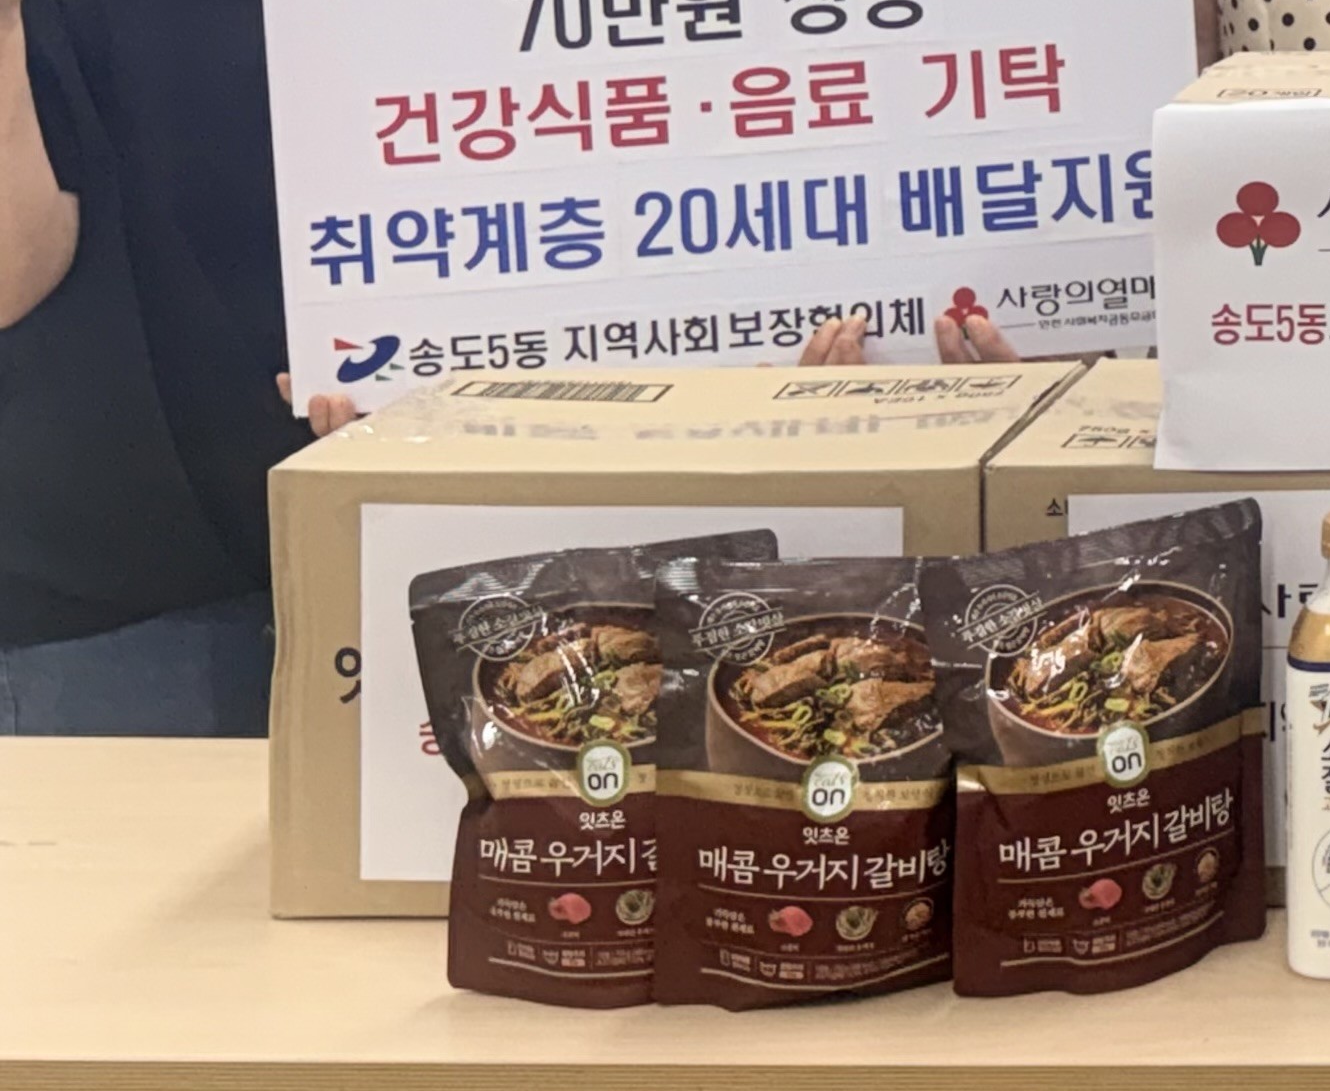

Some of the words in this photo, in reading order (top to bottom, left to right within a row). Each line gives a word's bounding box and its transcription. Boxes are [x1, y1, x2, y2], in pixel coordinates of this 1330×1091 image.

[922, 44, 1065, 122] 기탁
[309, 198, 605, 287] 취약계층
[635, 175, 869, 258] 20세대
[409, 330, 548, 376] 송도5동
[1112, 753, 1141, 773] on
[588, 773, 618, 790] on
[812, 789, 845, 806] on
[1107, 788, 1151, 814] 잇츠온
[579, 809, 627, 831] 잇츠온
[802, 826, 850, 846] 잇츠온
[999, 835, 1067, 872] 매콤
[1071, 812, 1160, 866] 우거지
[1163, 787, 1234, 844] 갈비탕
[480, 837, 537, 874] 매콤
[540, 837, 636, 877] 우거지
[698, 846, 760, 884] 매콤
[763, 853, 859, 891] 우거지
[863, 838, 951, 890] 갈비탕
